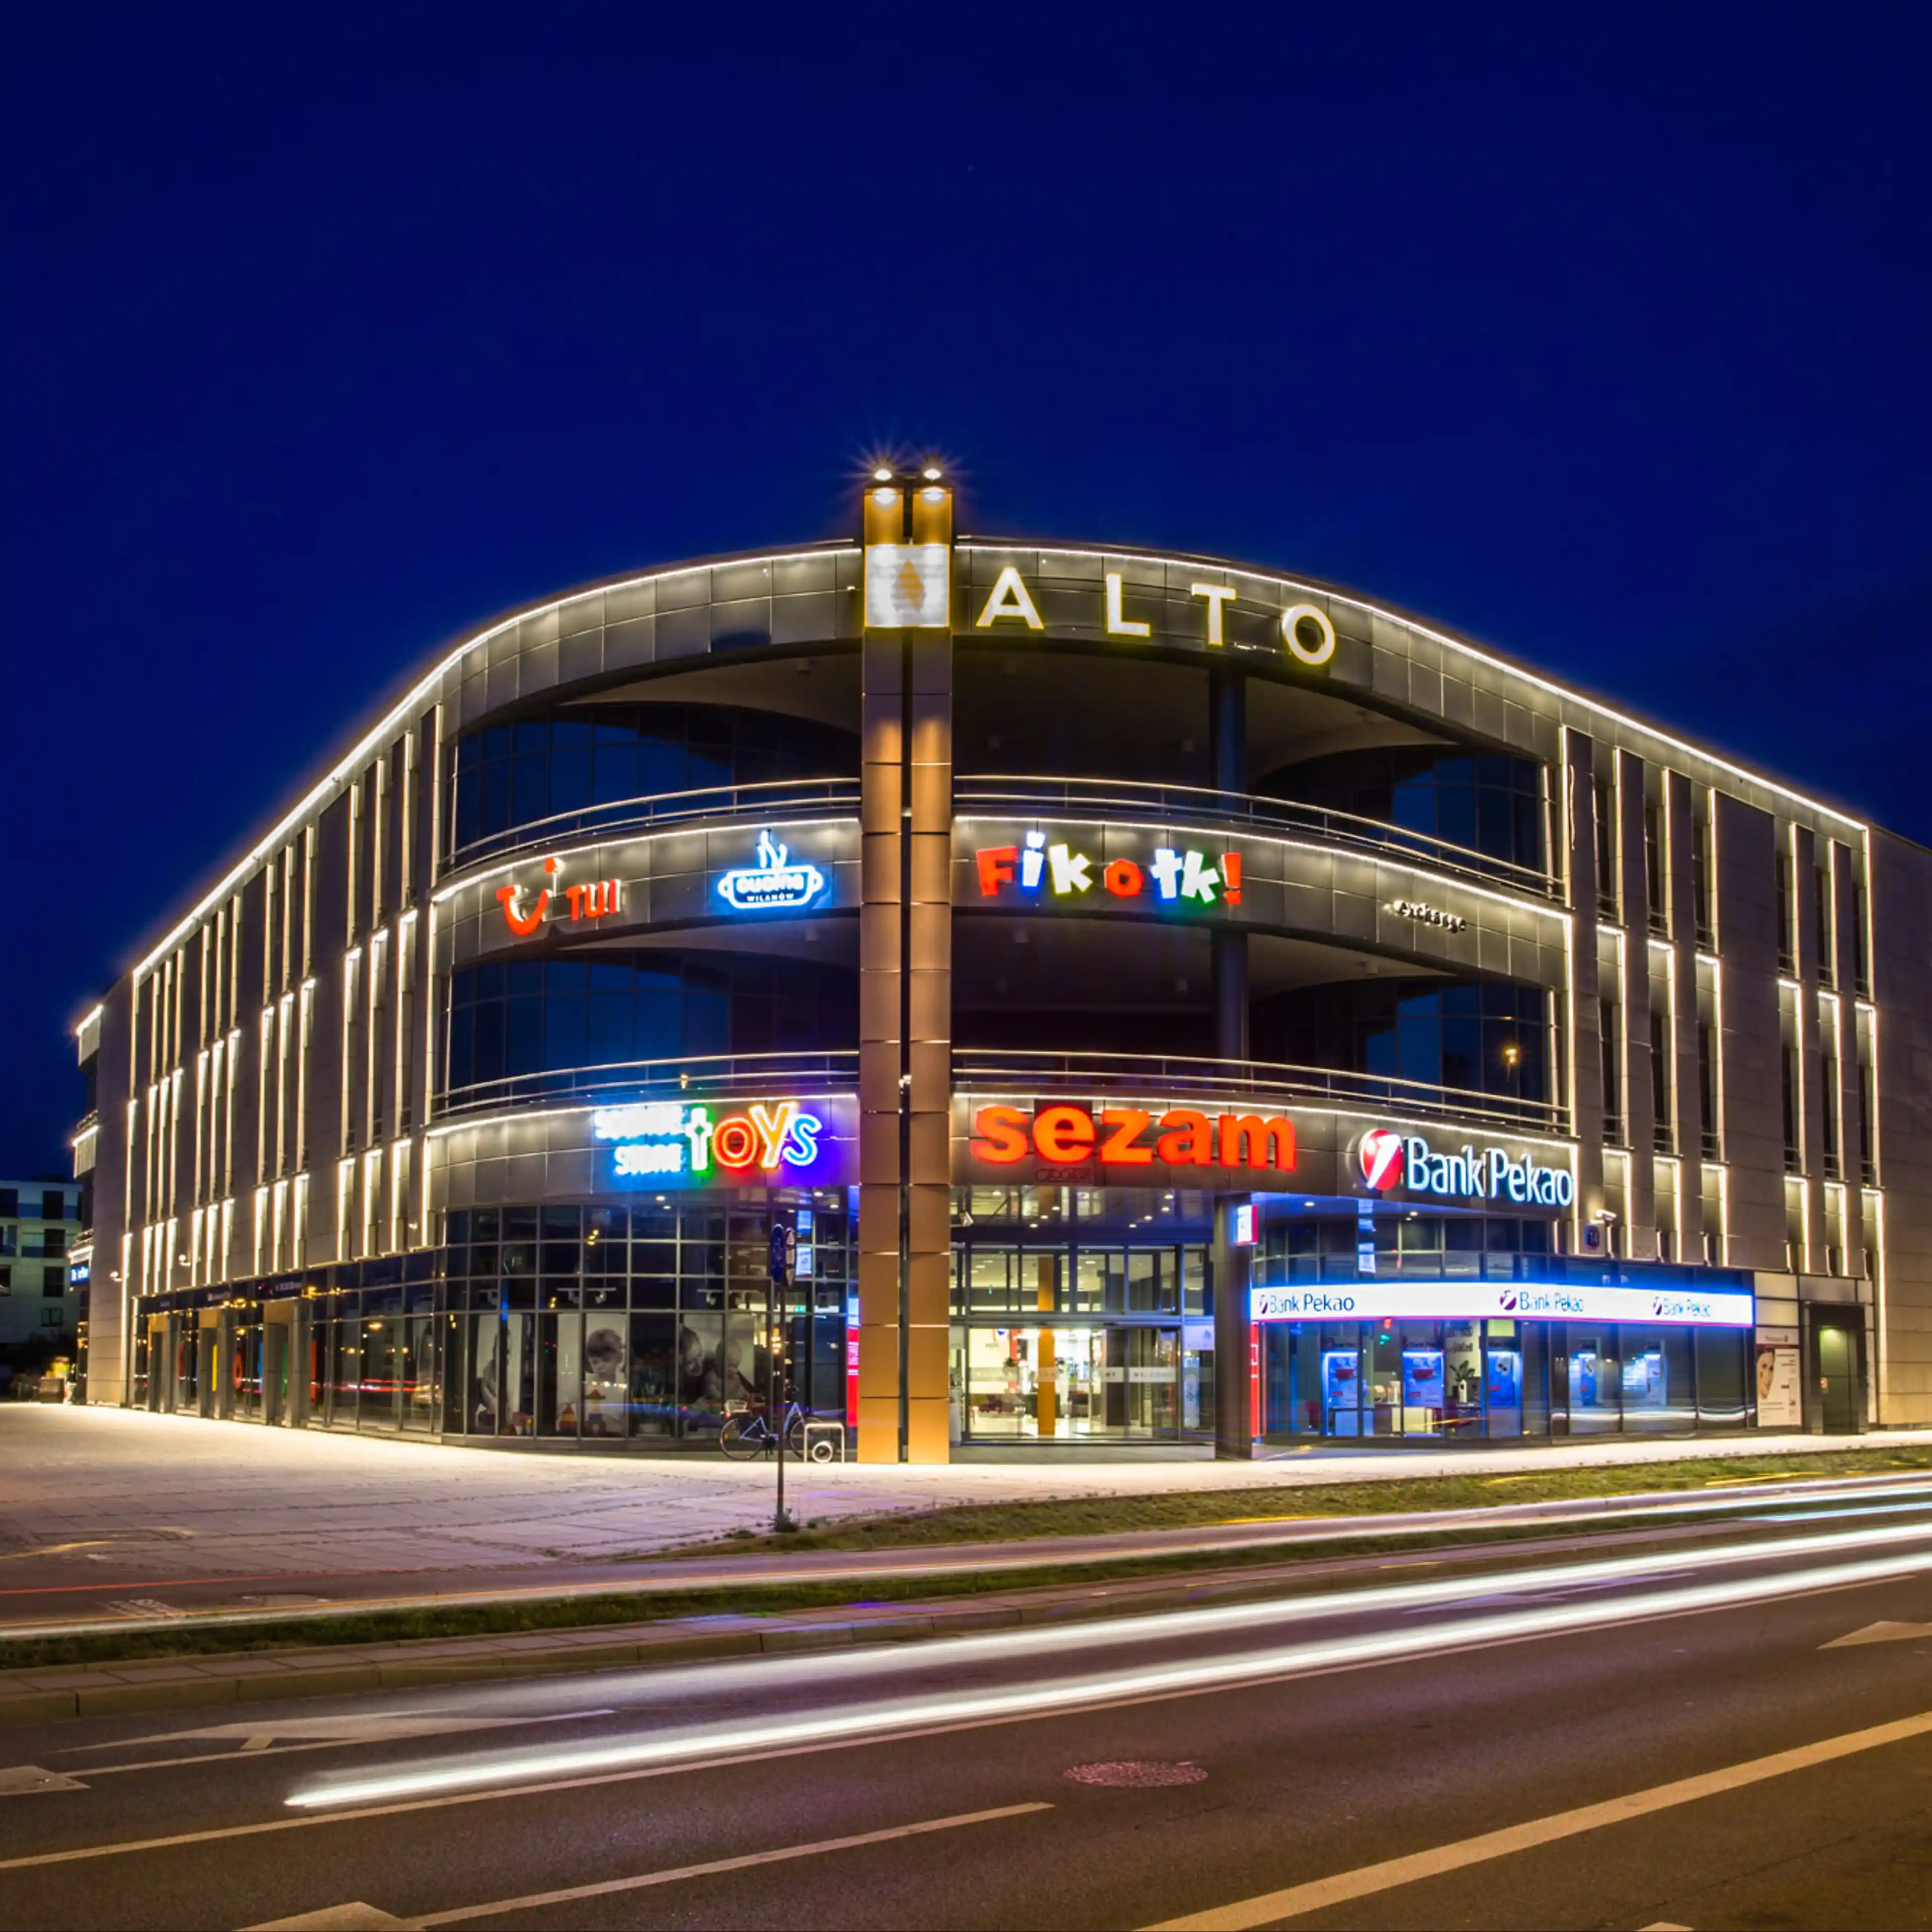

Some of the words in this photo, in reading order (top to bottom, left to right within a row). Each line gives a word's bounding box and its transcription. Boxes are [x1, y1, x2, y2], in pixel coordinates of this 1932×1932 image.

[976, 567, 1336, 665] ALTO
[566, 878, 621, 921] TUI
[971, 1104, 1296, 1171] sezam
[1407, 1136, 1485, 1197] Bank
[1486, 1148, 1573, 1206] Pekao
[1269, 1295, 1300, 1313] Bank
[1304, 1293, 1355, 1312] Pekao
